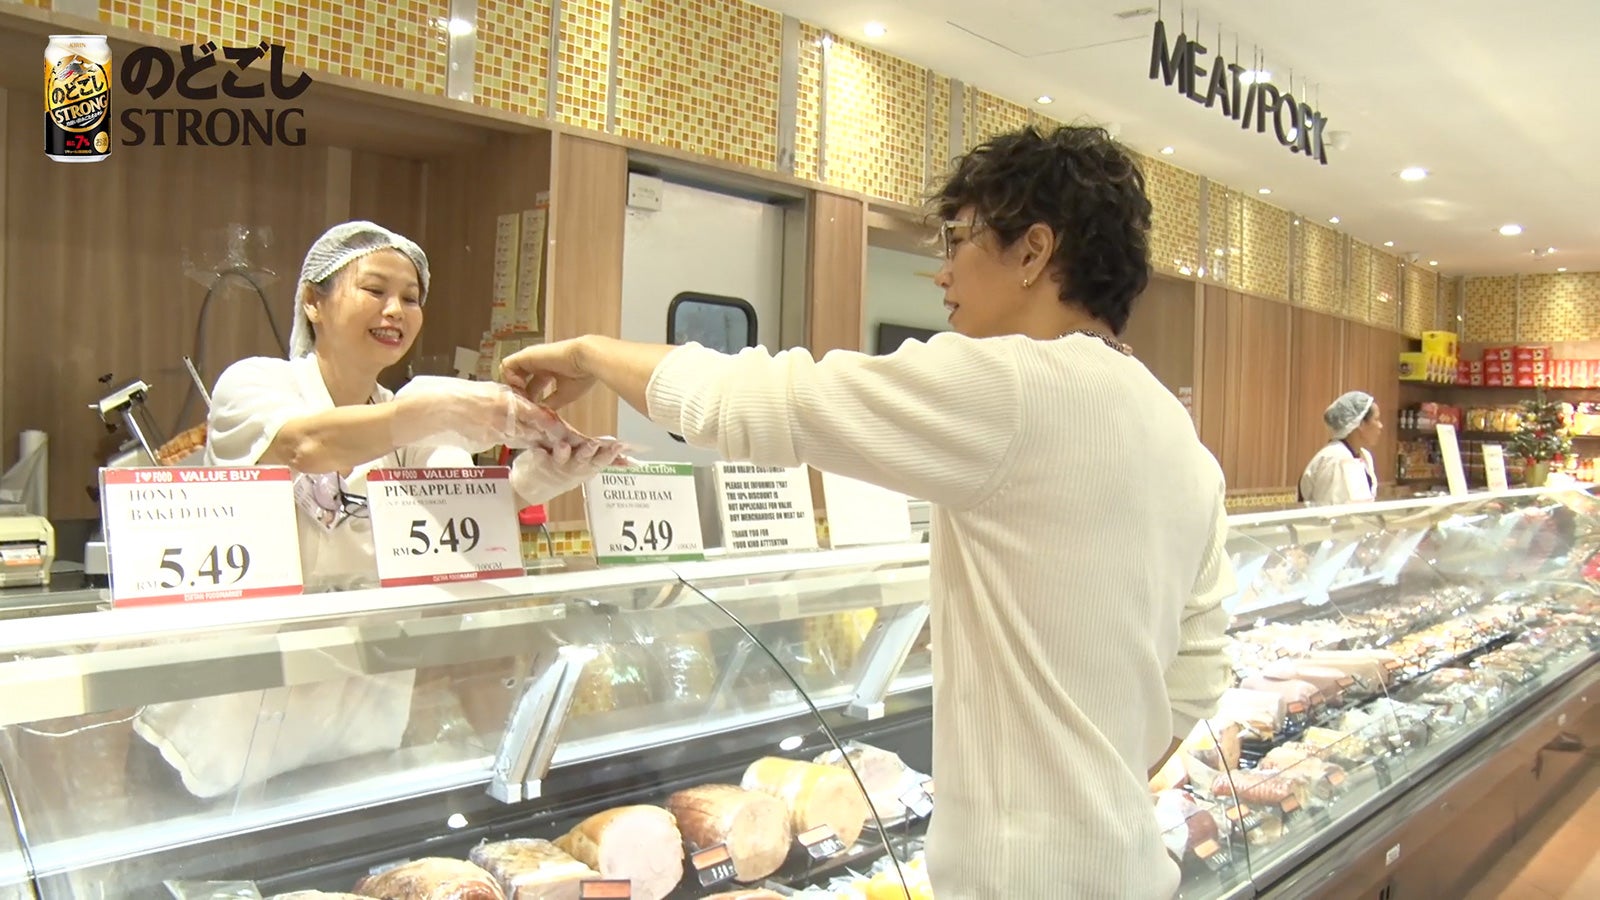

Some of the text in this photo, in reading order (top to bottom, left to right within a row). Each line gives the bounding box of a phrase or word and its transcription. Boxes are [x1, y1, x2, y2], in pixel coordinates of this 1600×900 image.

[179, 470, 227, 482] VALUE
[230, 470, 261, 481] BUY
[423, 469, 460, 479] VALUE
[462, 469, 485, 479] BUY
[601, 475, 637, 486] HONEY
[725, 481, 743, 490] PLEASE
[743, 481, 750, 489] BE
[385, 482, 497, 497] PINEAPPLE HAM
[603, 489, 673, 501] GRILLED HAM
[726, 492, 737, 500] THE
[748, 491, 772, 499] DISCOUNT
[778, 501, 793, 509] VALUE
[393, 517, 480, 557] RM 5.49
[609, 519, 673, 552] RM 5.49
[160, 544, 251, 589] 5.49
